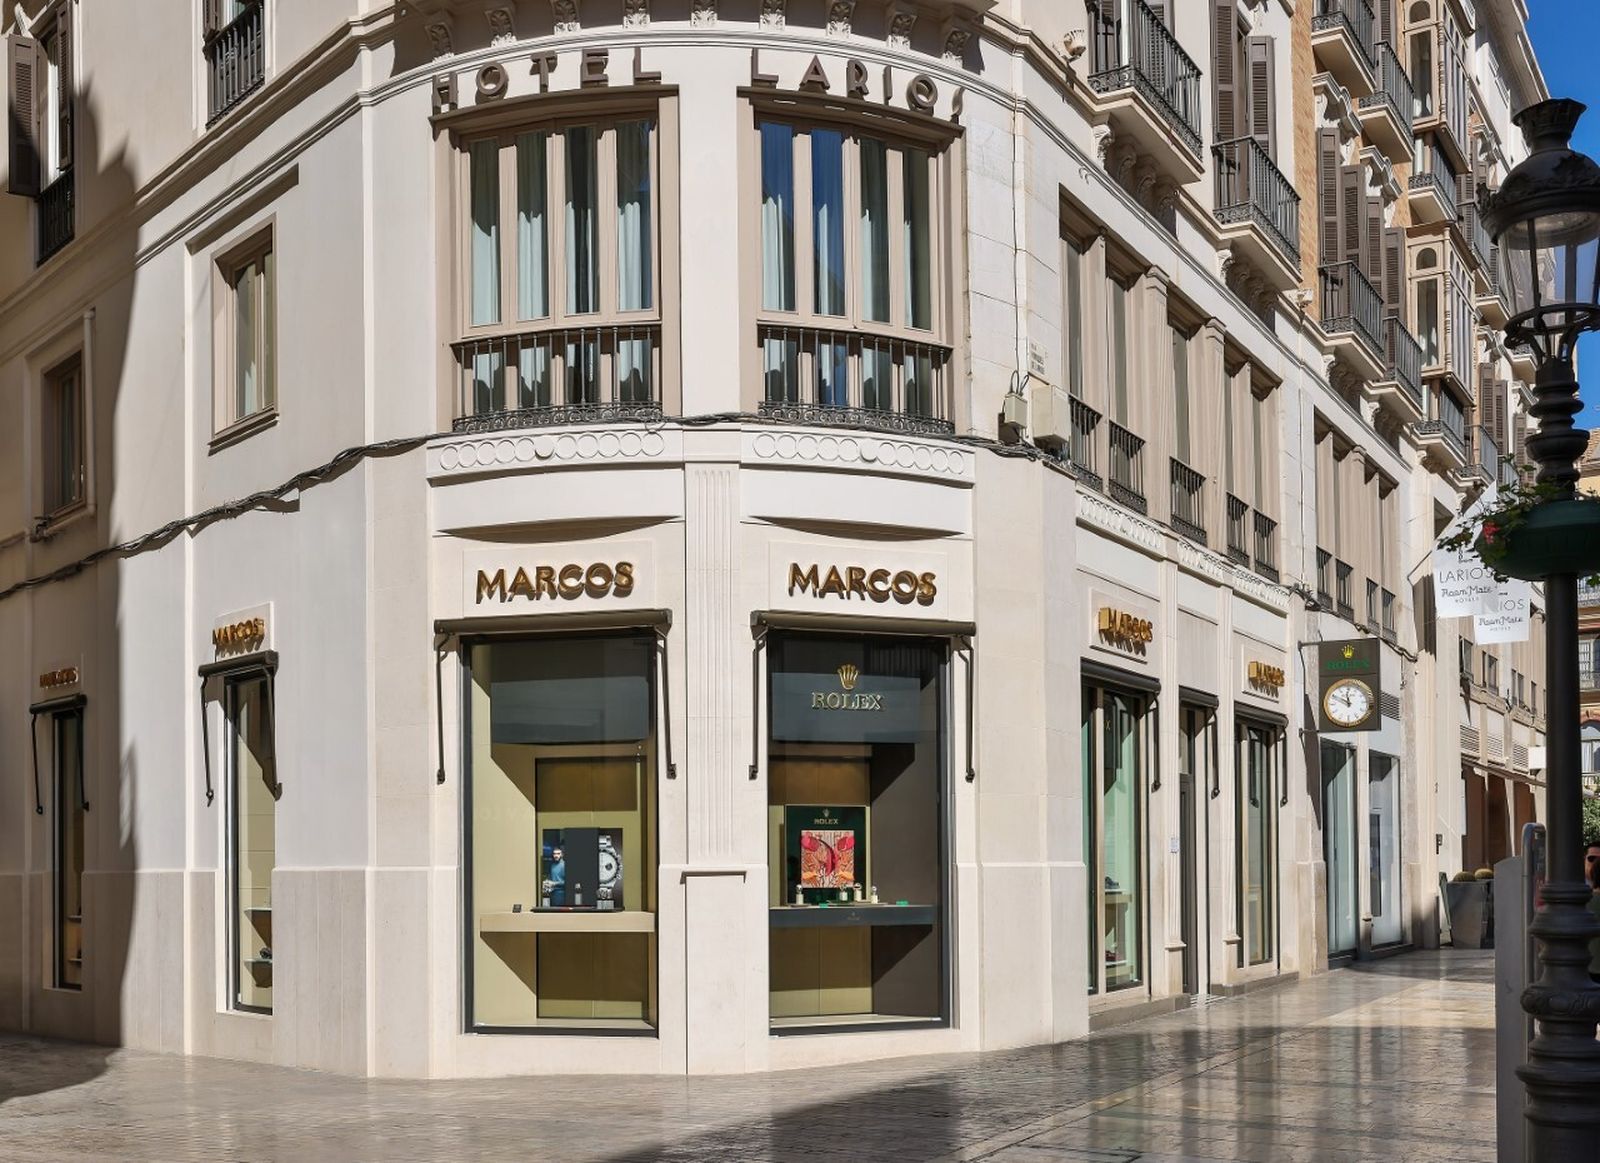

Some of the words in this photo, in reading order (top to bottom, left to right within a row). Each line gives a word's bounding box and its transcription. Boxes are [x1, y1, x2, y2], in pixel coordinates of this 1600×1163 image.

[432, 47, 661, 113] HOTEL
[751, 48, 965, 116] LARIOS
[475, 561, 635, 603] MARCOS
[788, 561, 937, 604] MARCOS
[1439, 567, 1494, 583] LARIOS
[1499, 599, 1525, 611] IOS
[811, 692, 882, 710] ROLEX
